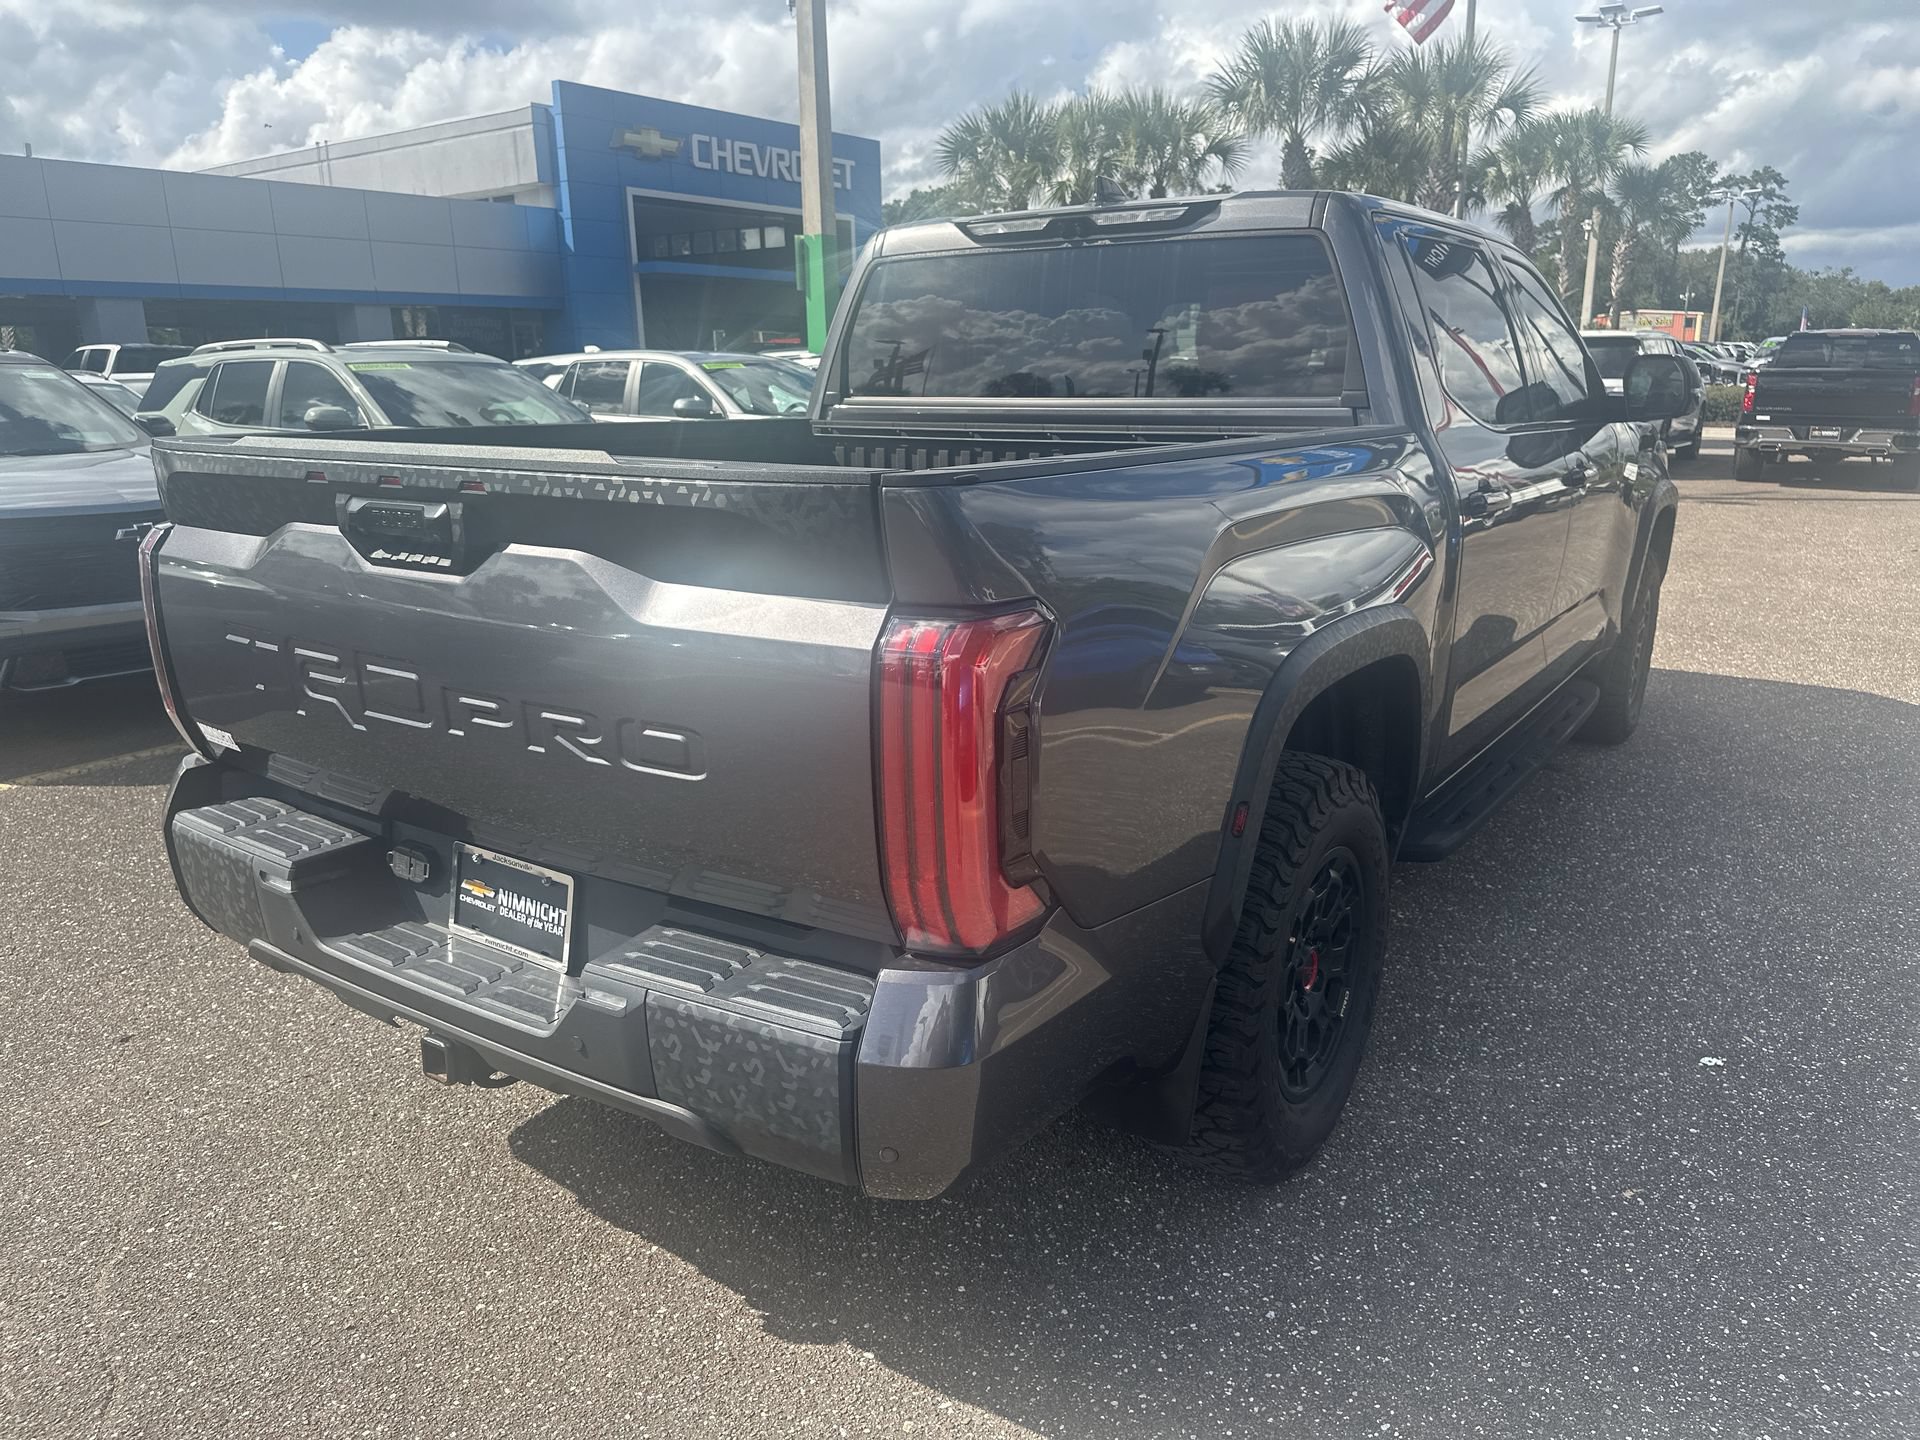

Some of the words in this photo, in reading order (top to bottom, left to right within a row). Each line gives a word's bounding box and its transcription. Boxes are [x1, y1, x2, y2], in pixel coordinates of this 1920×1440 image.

[691, 133, 856, 190] CHEVROET
[492, 854, 533, 871] Jacksonville
[459, 894, 496, 912] CHEVROLET
[498, 888, 567, 927] NIMNICHT
[499, 906, 526, 924] DEALER
[543, 921, 563, 937] YEAR
[484, 938, 529, 959] nimnicht.com
